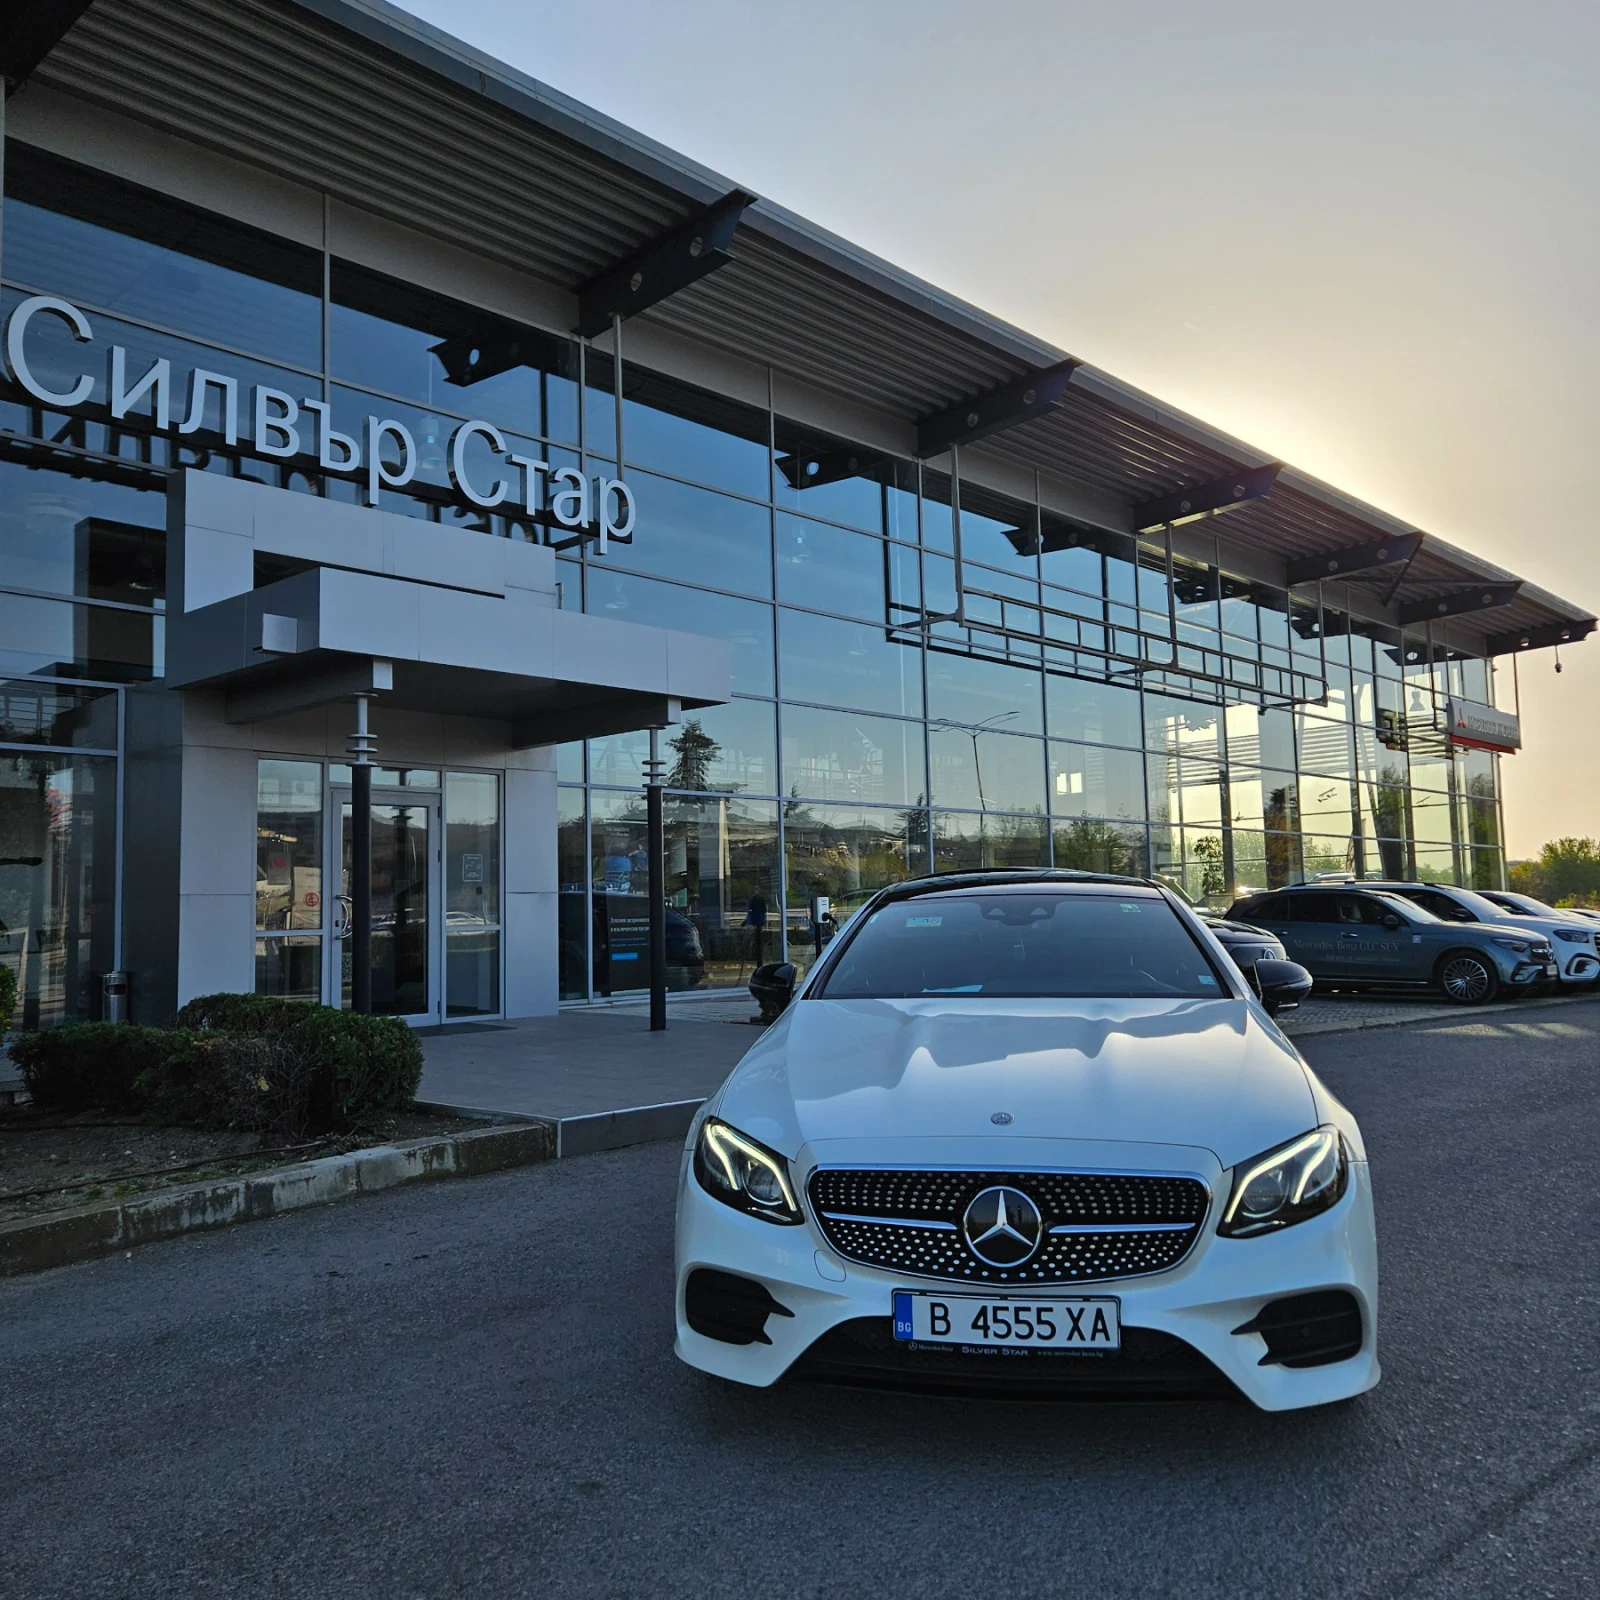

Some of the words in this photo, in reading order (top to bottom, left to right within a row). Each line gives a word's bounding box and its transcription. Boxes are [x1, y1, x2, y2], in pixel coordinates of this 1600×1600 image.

[5, 295, 417, 506] Силвър
[448, 420, 637, 556] Стар
[1360, 941, 1378, 952] GLC
[1381, 942, 1400, 952] SUV
[897, 1321, 912, 1333] BG
[971, 1304, 1057, 1341] 4555
[961, 1346, 998, 1355] SILVER
[1002, 1347, 1029, 1356] STAR
